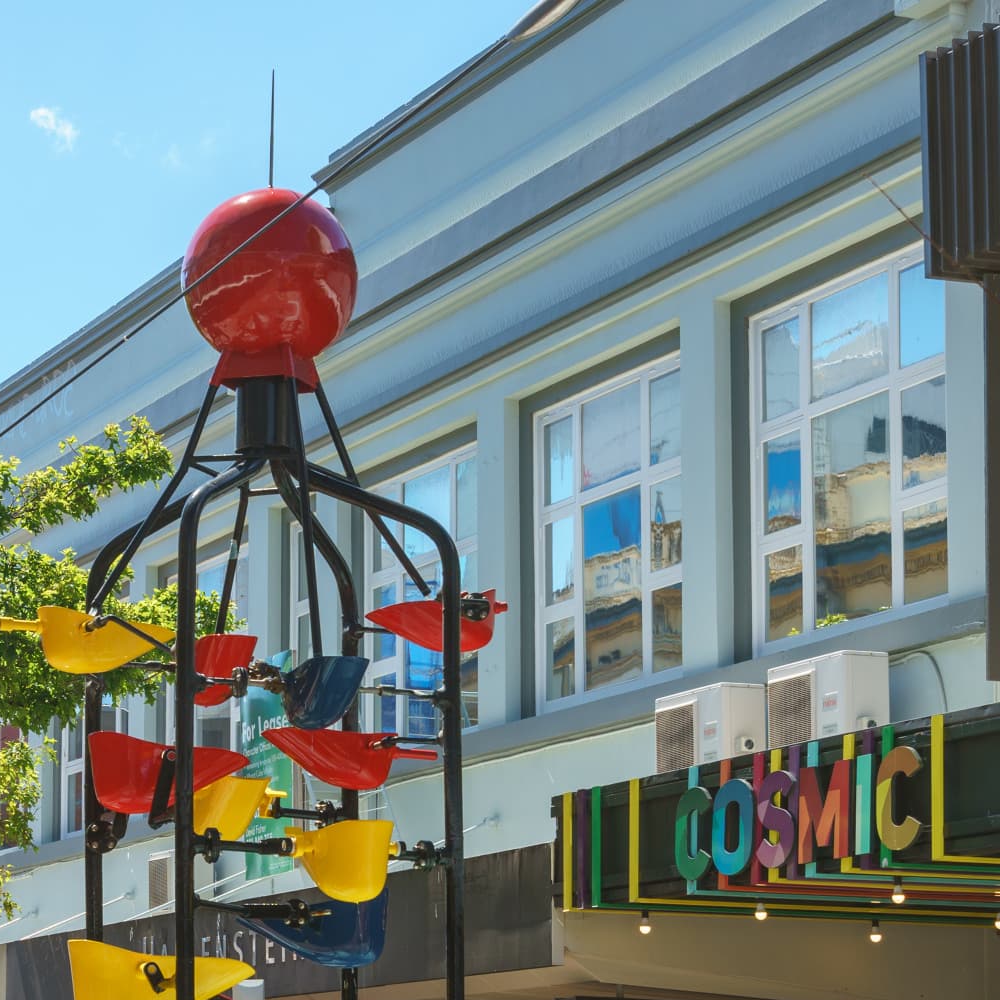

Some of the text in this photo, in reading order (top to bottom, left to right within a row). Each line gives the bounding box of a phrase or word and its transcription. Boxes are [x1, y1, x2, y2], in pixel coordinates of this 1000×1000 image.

[242, 714, 289, 743] For Lease
[675, 745, 922, 881] COSMIC
